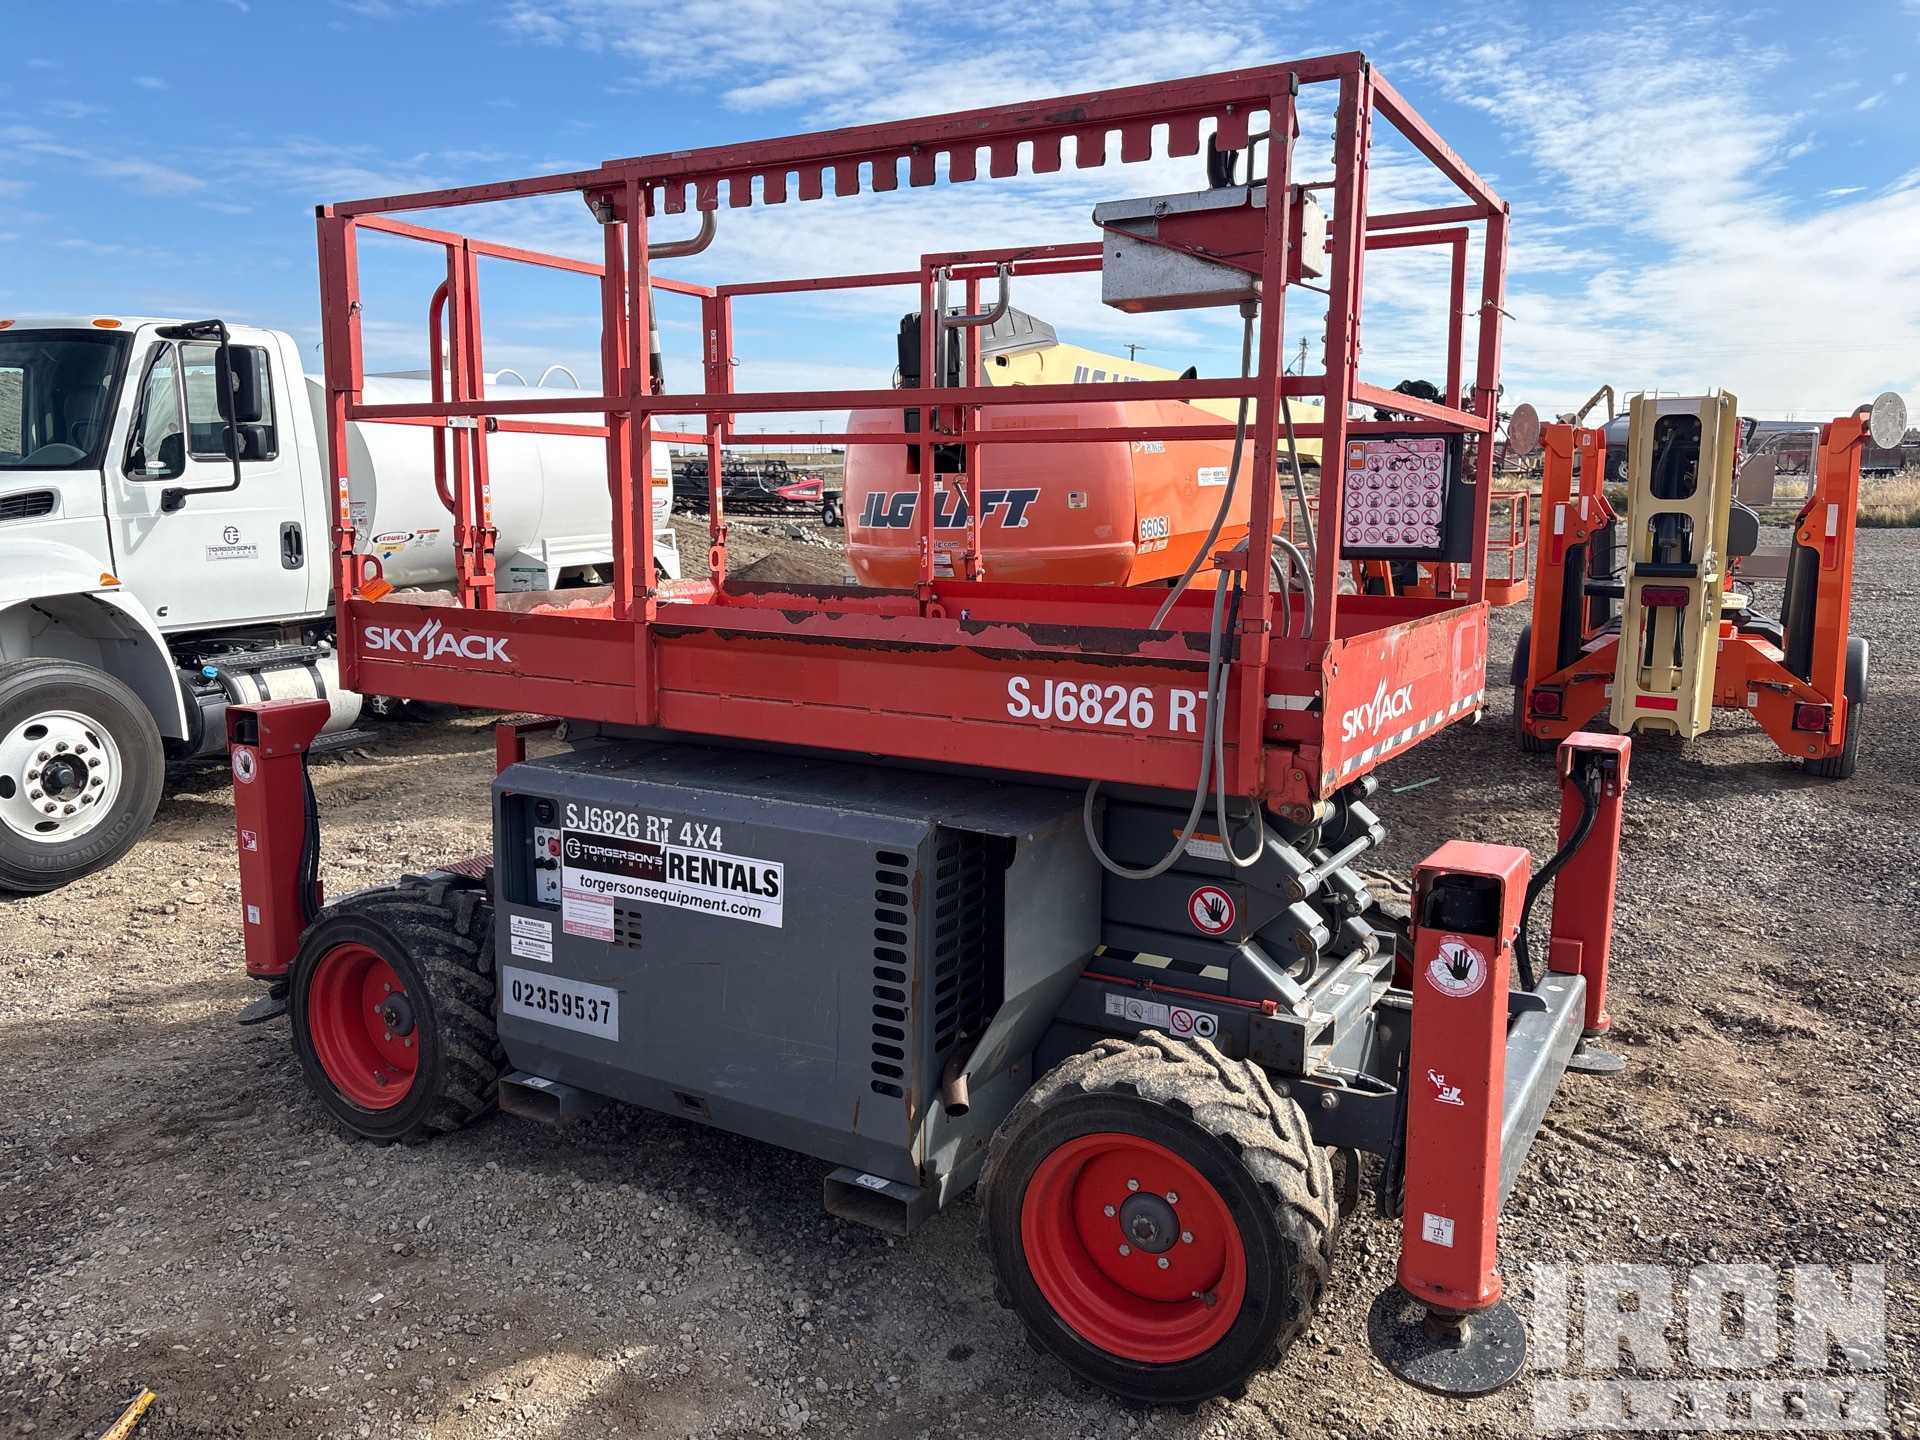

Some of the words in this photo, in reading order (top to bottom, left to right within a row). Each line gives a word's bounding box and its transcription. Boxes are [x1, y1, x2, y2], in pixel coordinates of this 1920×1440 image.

[859, 491, 919, 529] JLG
[1140, 516, 1169, 539] 660SJ
[207, 545, 256, 553] TORGERSON'S
[364, 618, 512, 662] SKYJACK
[1007, 676, 1154, 729] SJ6826
[1341, 676, 1413, 742] SKYJACK
[26, 812, 134, 868] CONTINENTAL
[566, 803, 640, 838] SJ6826
[646, 815, 673, 843] RT
[679, 821, 723, 851] 4X4
[582, 844, 663, 865] TORGERSON'S
[584, 854, 662, 872] EQUIPMENT
[669, 852, 779, 897] RENTALS
[580, 874, 762, 918] torgersonsequipment.com
[524, 920, 545, 929] WARNING
[525, 941, 546, 950] WARNING
[512, 979, 611, 1025] 02359537
